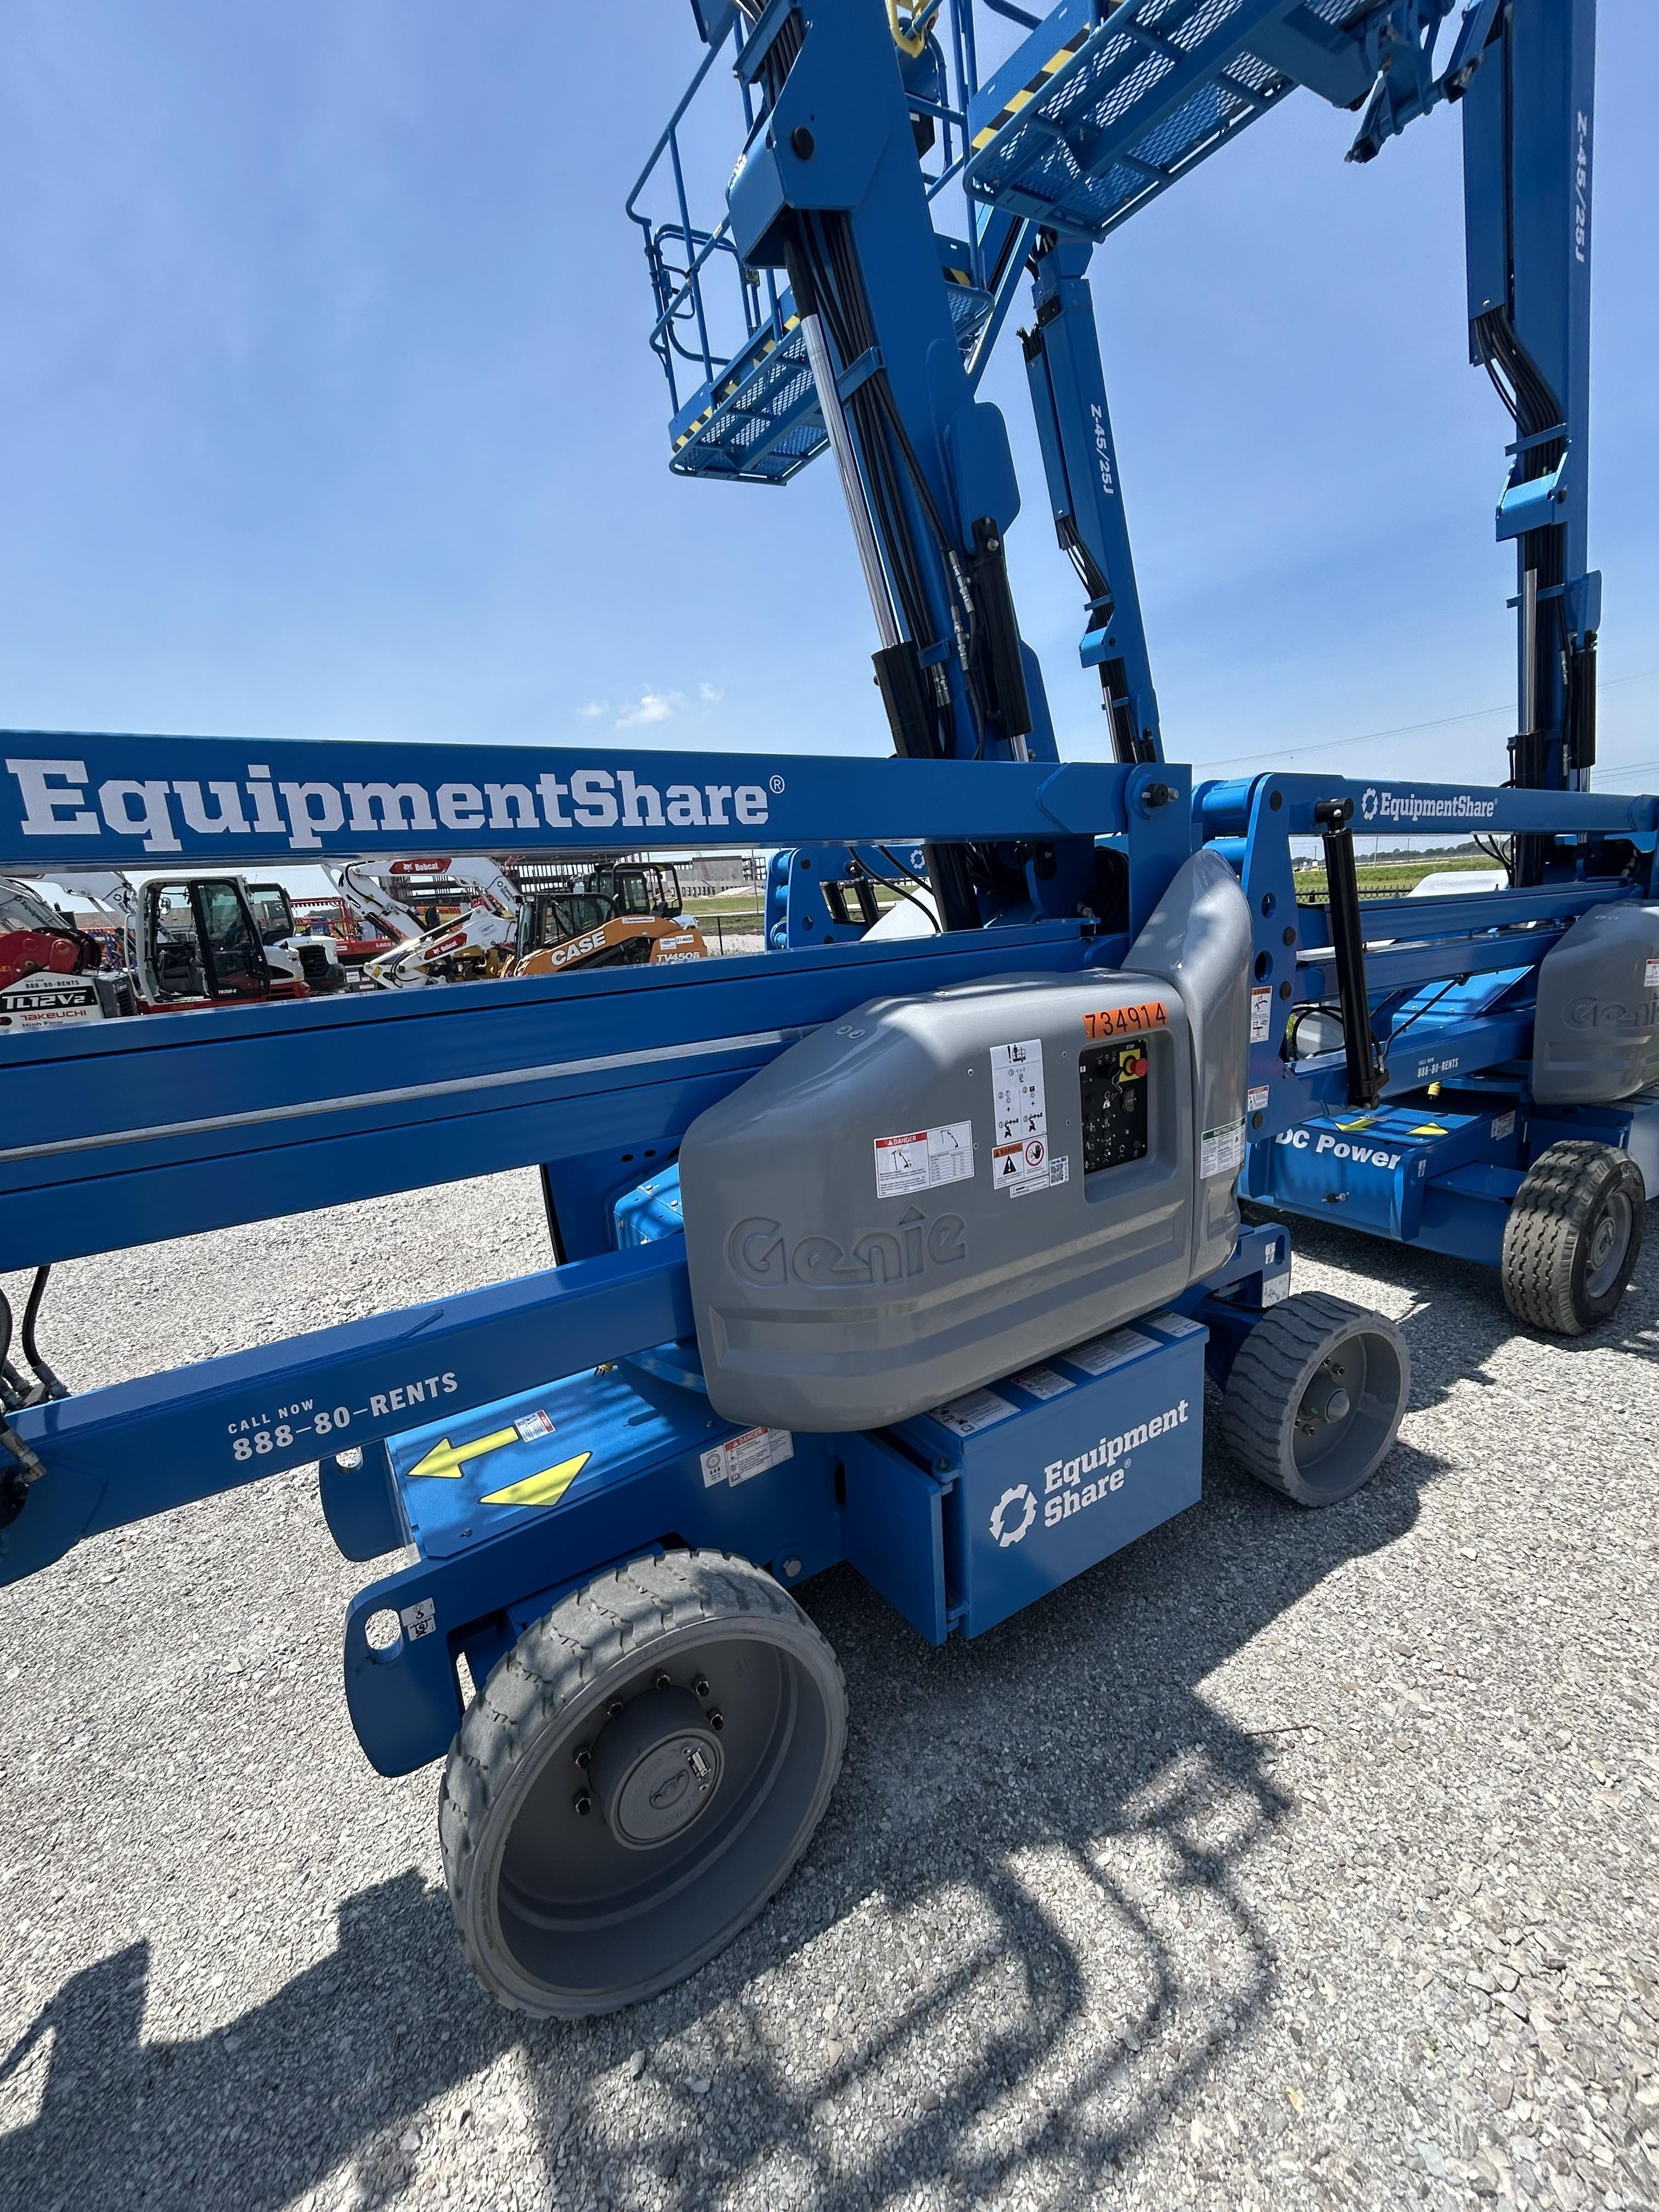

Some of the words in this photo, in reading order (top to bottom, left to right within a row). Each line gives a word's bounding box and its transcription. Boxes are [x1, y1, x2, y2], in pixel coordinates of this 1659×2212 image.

[1576, 111, 1587, 262] Z-45/25J
[1091, 403, 1114, 494] Z-45/25J
[415, 863, 439, 871] Bobcat
[441, 940, 458, 952] Bobcat
[551, 930, 606, 966] CASE
[26, 980, 80, 989] 888-80-RENTS
[1085, 1003, 1166, 1038] 734914
[1562, 992, 1659, 1031] Geni
[1418, 1058, 1459, 1078] 888-80-RENTS
[894, 1136, 917, 1145] DANGER
[1275, 1128, 1310, 1148] DC
[1316, 1134, 1401, 1170] Power
[726, 1205, 967, 1289] Genie
[228, 1413, 270, 1434] CALL
[278, 1398, 314, 1418] NOW
[233, 1372, 458, 1461] 888-80-RENTS
[739, 1429, 763, 1444] DANGER
[1044, 1399, 1188, 1494] Equipment
